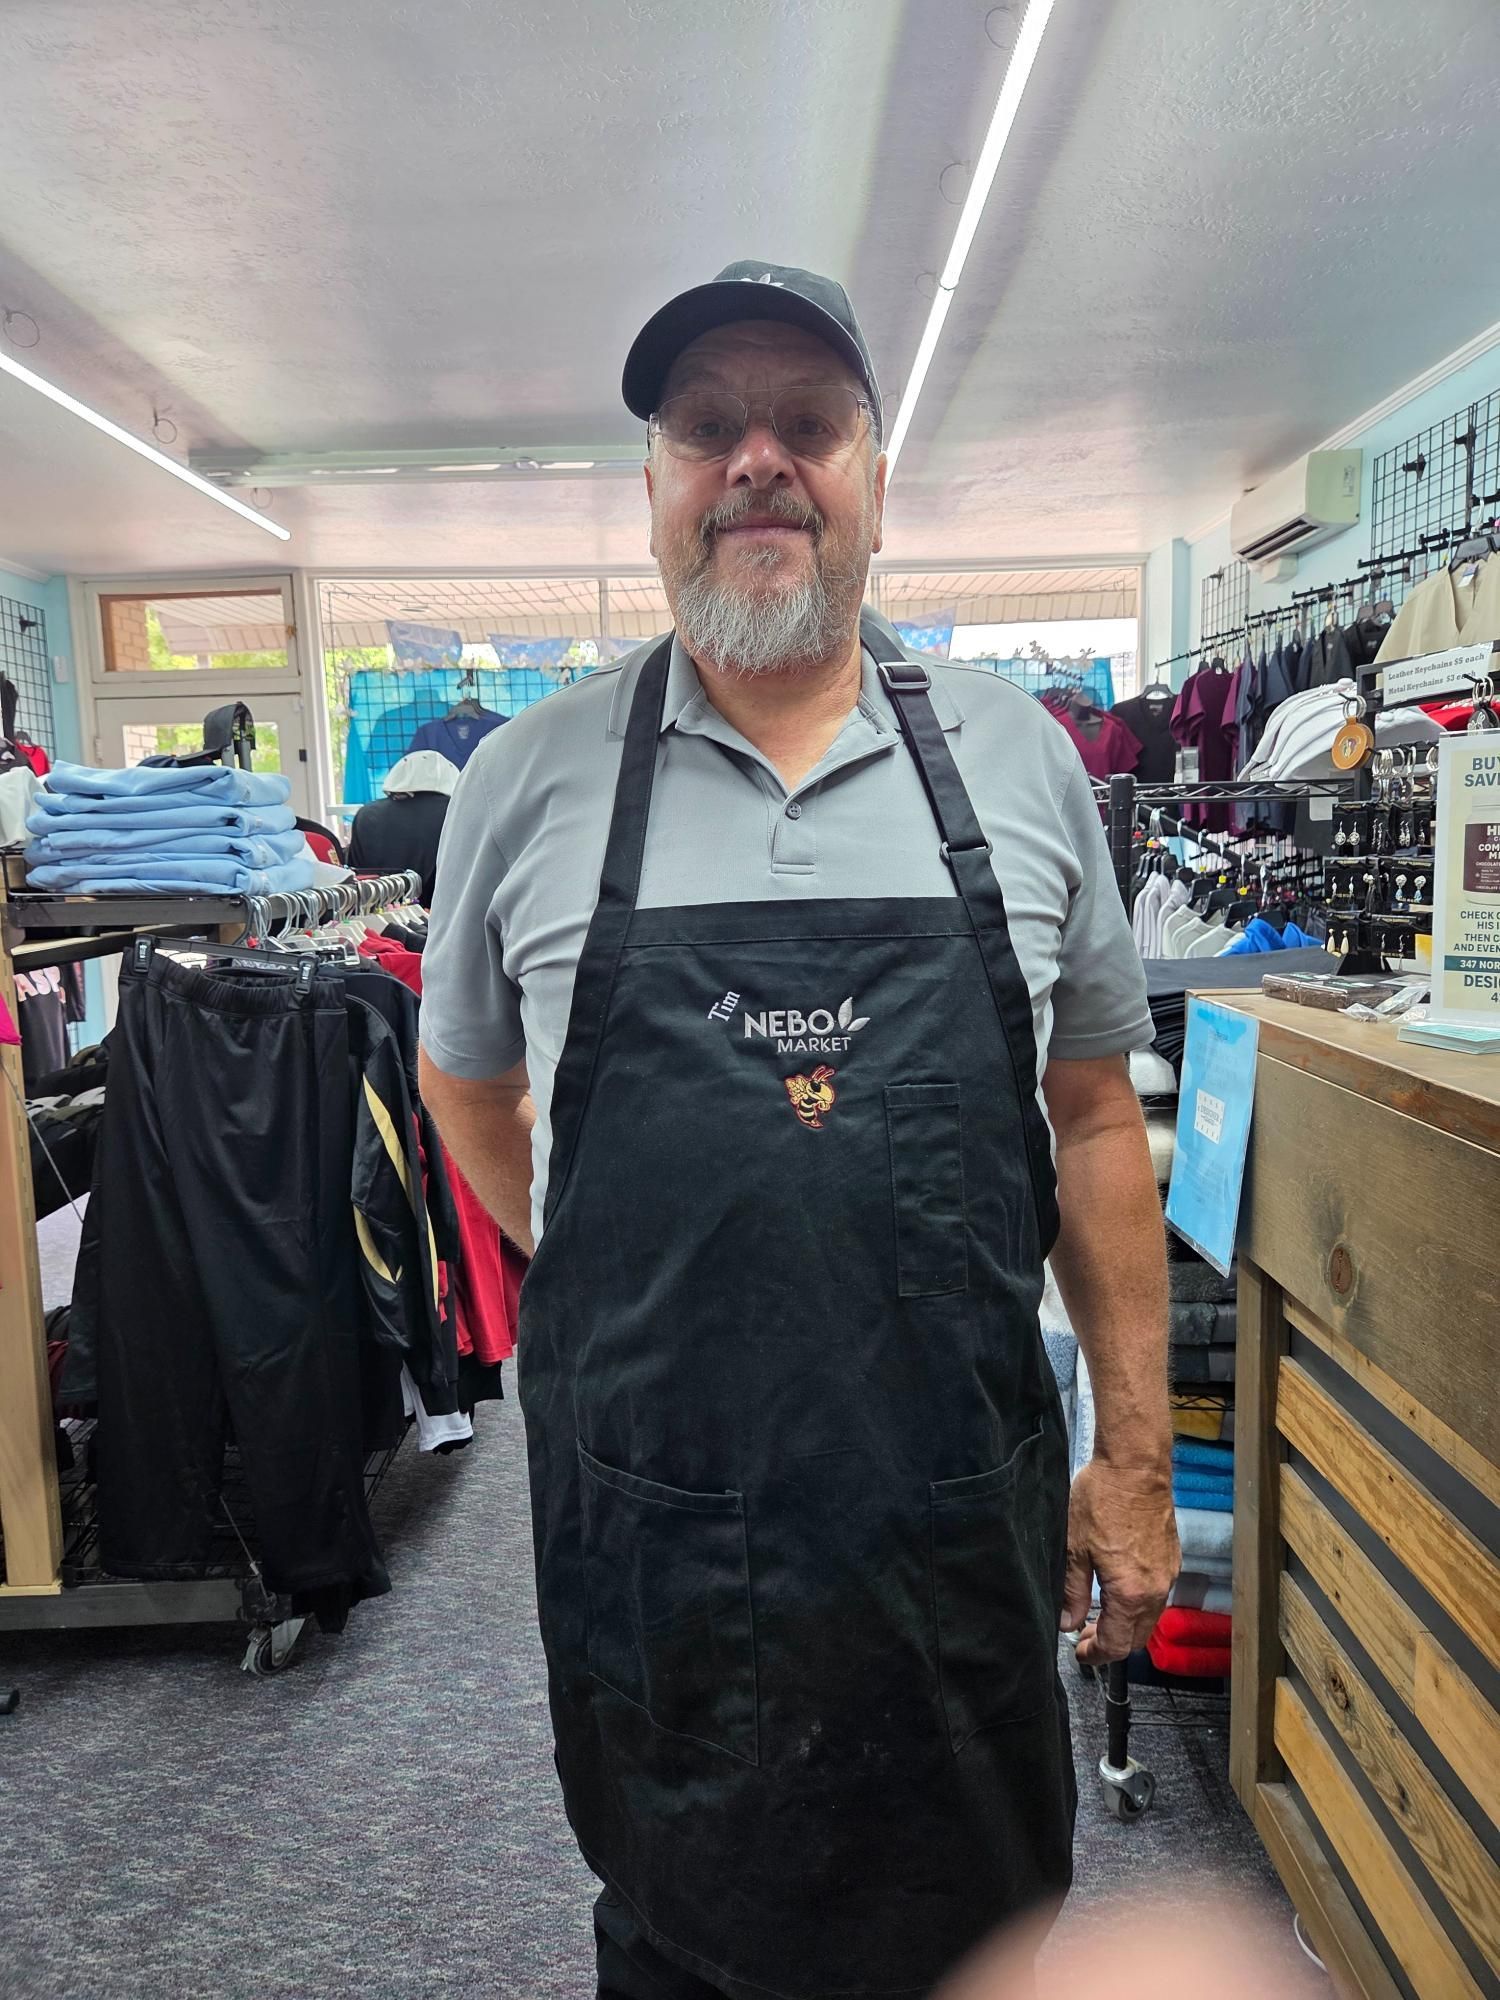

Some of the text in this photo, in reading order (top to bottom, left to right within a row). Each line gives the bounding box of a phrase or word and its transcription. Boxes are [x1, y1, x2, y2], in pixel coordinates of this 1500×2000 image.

[1388, 670, 1414, 680] Leather
[1414, 660, 1453, 674] Keychains
[1465, 653, 1485, 663] each
[1388, 684, 1406, 695] Metal
[1407, 678, 1444, 690] Keychains
[1460, 911, 1494, 920] CHECK
[1477, 921, 1494, 930] HIS
[1464, 933, 1491, 942] THEN
[1453, 943, 1475, 952] AND
[1460, 959, 1500, 970] 347 NOR
[13, 966, 66, 1004] ASP
[1464, 974, 1500, 989] DESI
[708, 991, 741, 1022] Tim
[744, 1008, 835, 1038] NEBO
[777, 1037, 852, 1053] MARKET
